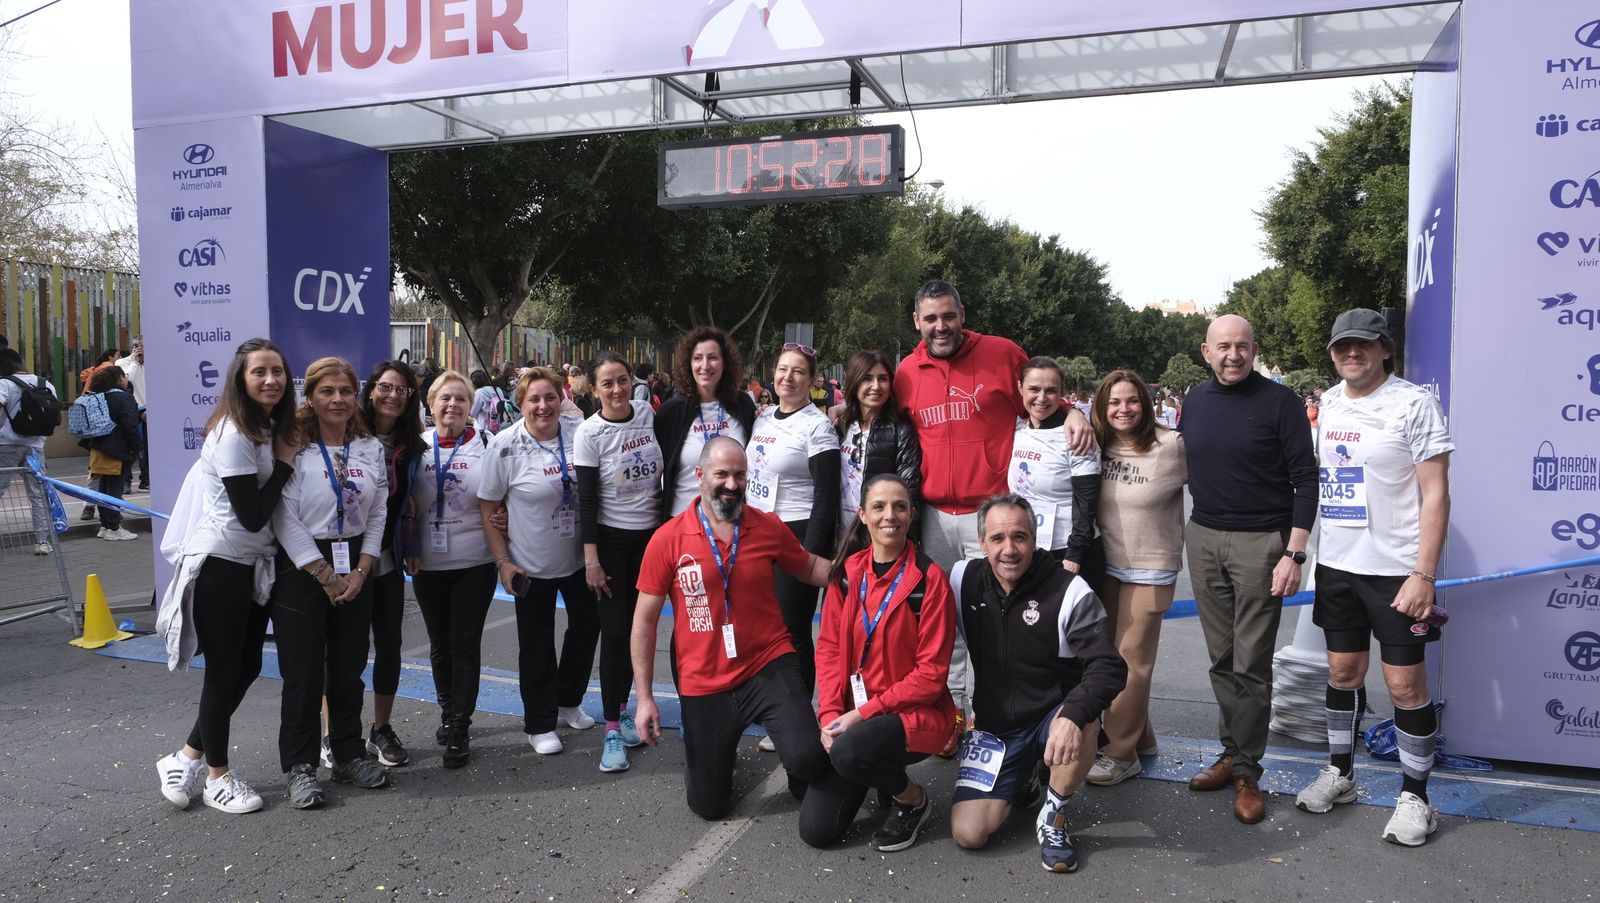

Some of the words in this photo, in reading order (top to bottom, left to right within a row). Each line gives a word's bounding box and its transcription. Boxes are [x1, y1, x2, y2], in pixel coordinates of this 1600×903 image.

[272, 0, 528, 77] MUJER
[172, 166, 227, 180] HYUNDAI
[180, 181, 221, 191] Almerialva
[187, 206, 232, 220] cajamar
[178, 247, 216, 267] CASI
[191, 282, 231, 296] vithas
[294, 267, 372, 315] CDX
[184, 327, 231, 346] aqualia
[621, 435, 653, 453] MUJER
[752, 434, 777, 444] MUJER
[1325, 430, 1361, 442] MUJER
[1014, 449, 1042, 462] MUJER
[623, 461, 657, 480] 1363
[1560, 455, 1597, 474] AARÓN
[747, 478, 770, 498] 1359
[1321, 483, 1356, 499] 2045
[1559, 475, 1597, 491] PIEDRA
[686, 607, 711, 617] PIEDRA
[690, 617, 714, 632] CASH
